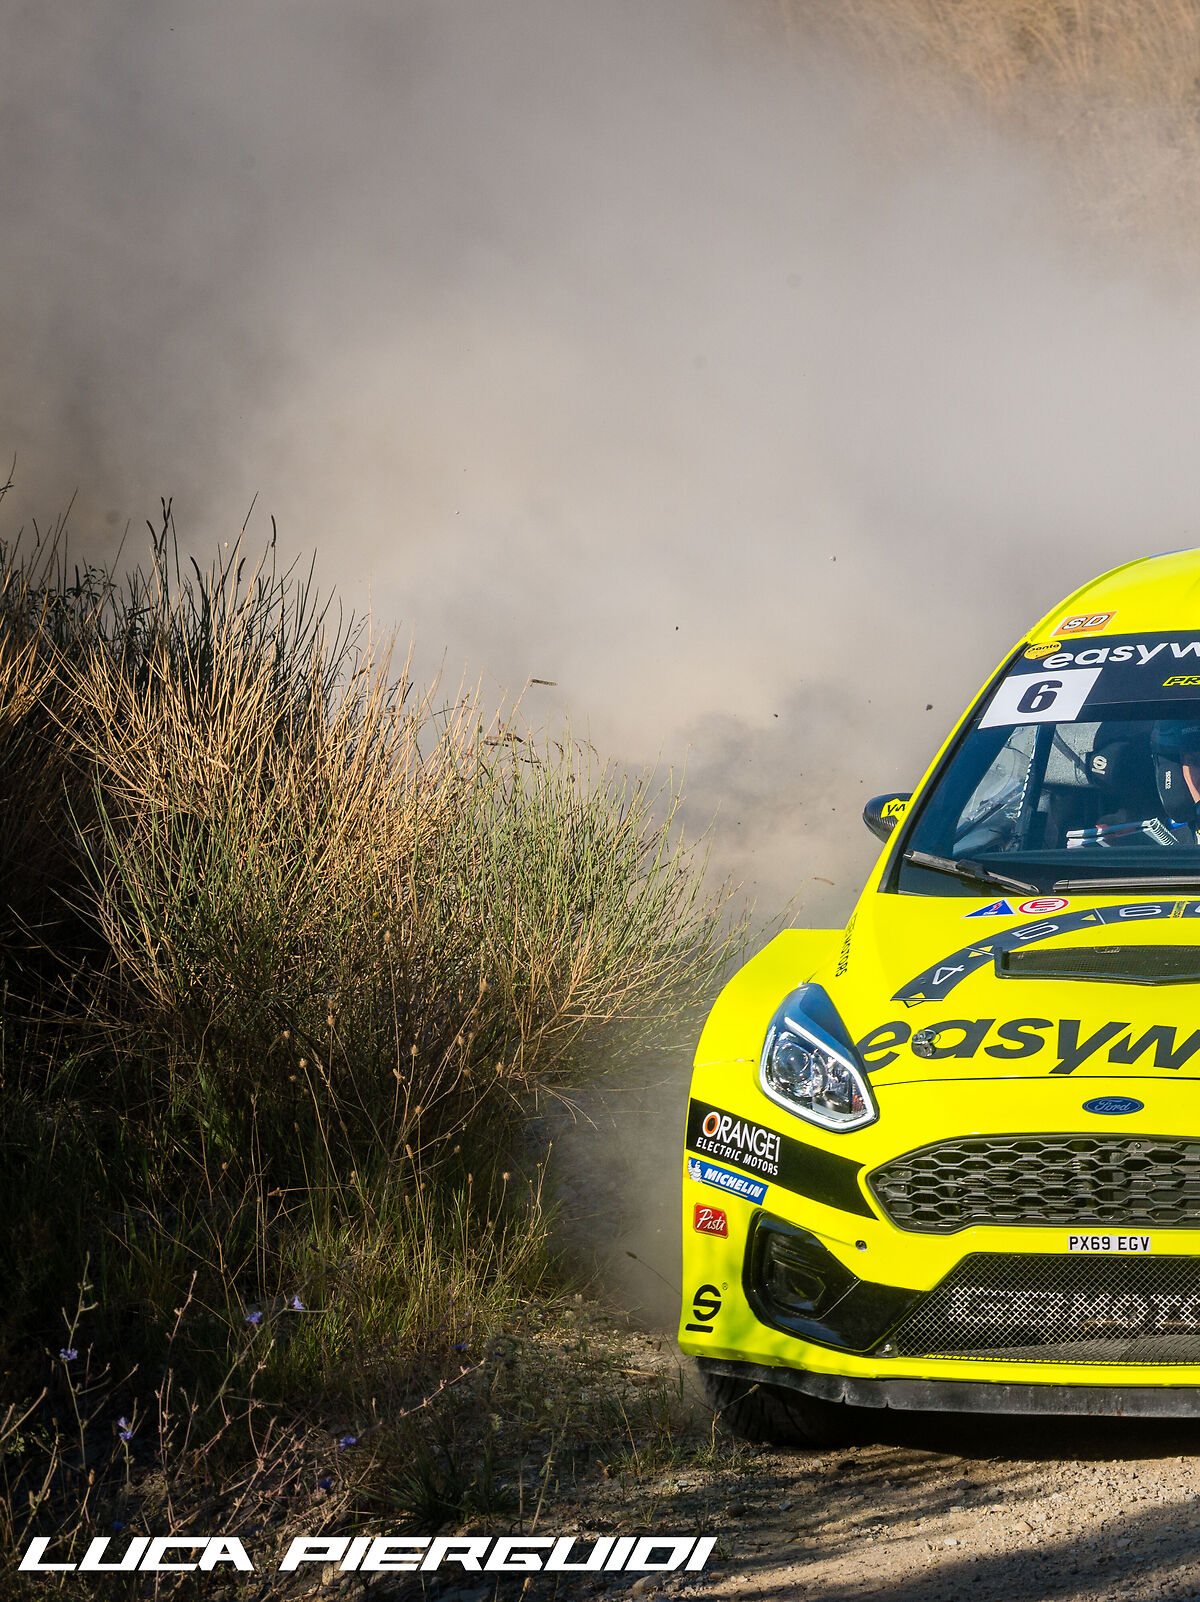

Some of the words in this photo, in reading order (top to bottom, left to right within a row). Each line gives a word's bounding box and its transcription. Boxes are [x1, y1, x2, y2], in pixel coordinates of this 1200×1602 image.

[1061, 614, 1111, 630] SD
[1016, 680, 1063, 713] 6
[932, 965, 964, 985] 4
[1012, 922, 1060, 940] 5
[1119, 905, 1162, 917] 6
[702, 1111, 781, 1163] ORANGE1
[696, 1136, 742, 1161] ELECTRIC
[742, 1153, 778, 1176] MOTORS
[704, 1168, 763, 1199] MICHELIN
[1069, 1236, 1111, 1251] PX69
[1117, 1236, 1151, 1252] EGV
